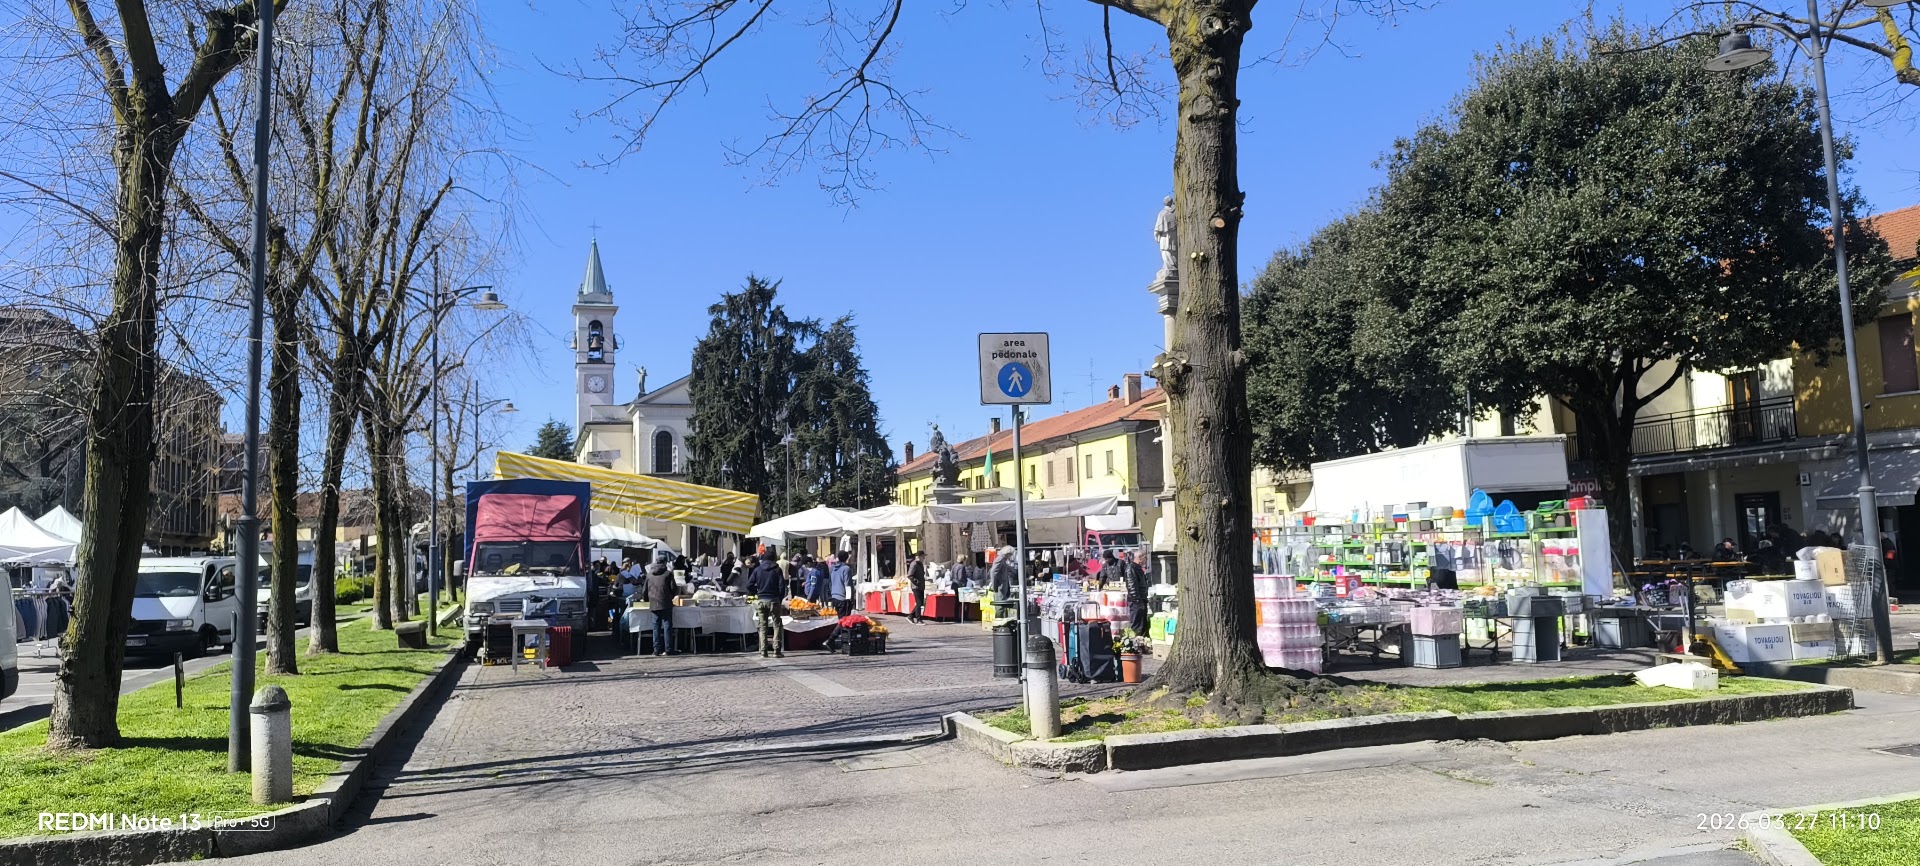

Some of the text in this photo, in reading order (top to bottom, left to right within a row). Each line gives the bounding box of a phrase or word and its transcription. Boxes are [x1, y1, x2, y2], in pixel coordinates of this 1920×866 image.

[992, 350, 1037, 360] pedonale
[1793, 591, 1821, 600] TOVAGLIOLI
[1754, 636, 1783, 645] TOVAGLIOLI
